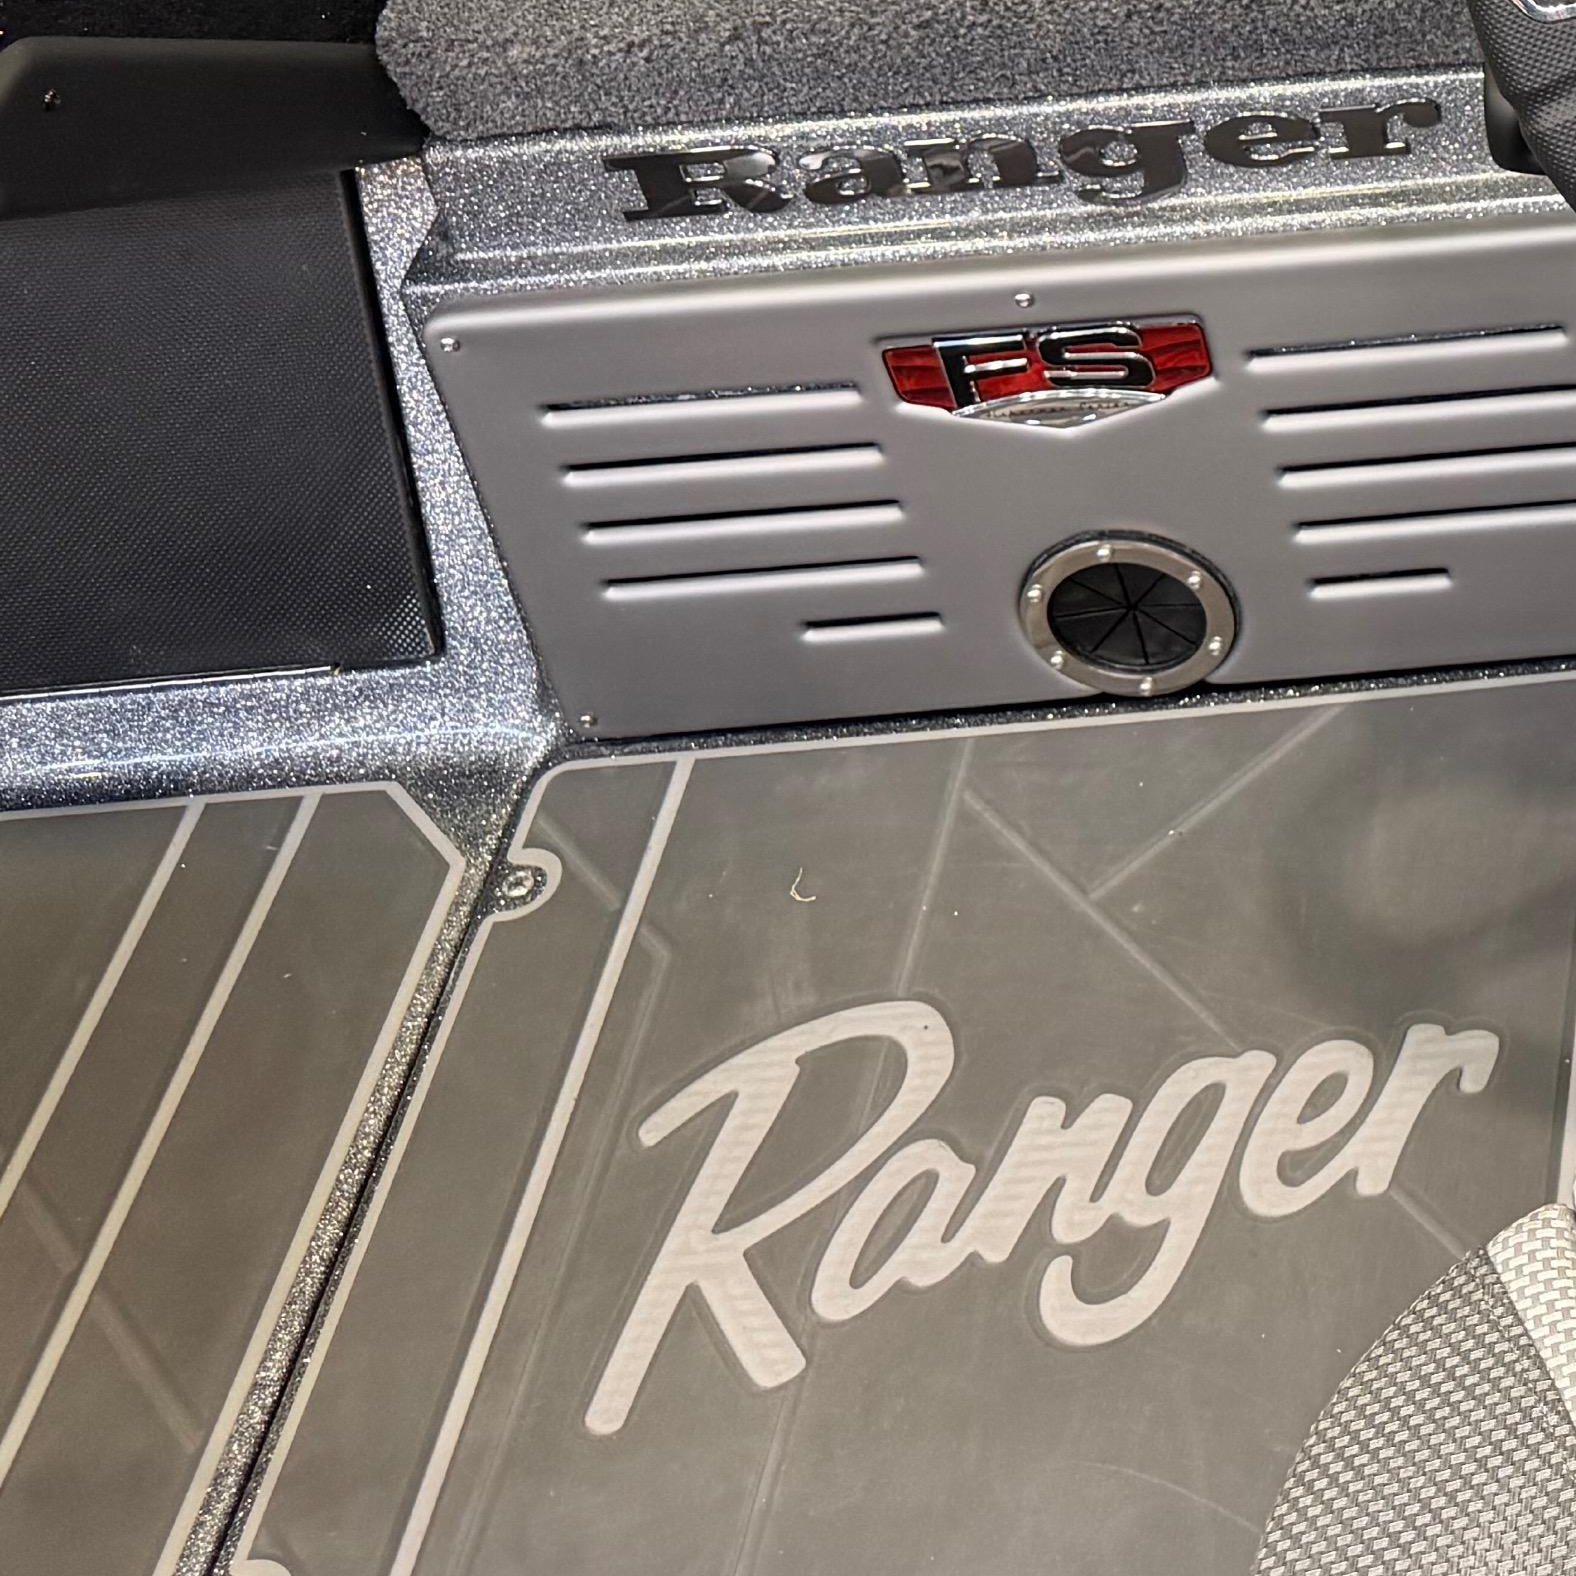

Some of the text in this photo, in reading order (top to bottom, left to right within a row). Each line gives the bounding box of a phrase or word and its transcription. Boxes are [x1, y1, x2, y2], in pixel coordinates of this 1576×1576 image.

[604, 96, 1442, 222] Ranger
[931, 322, 1157, 408] FS
[584, 999, 1500, 1436] Ranger
